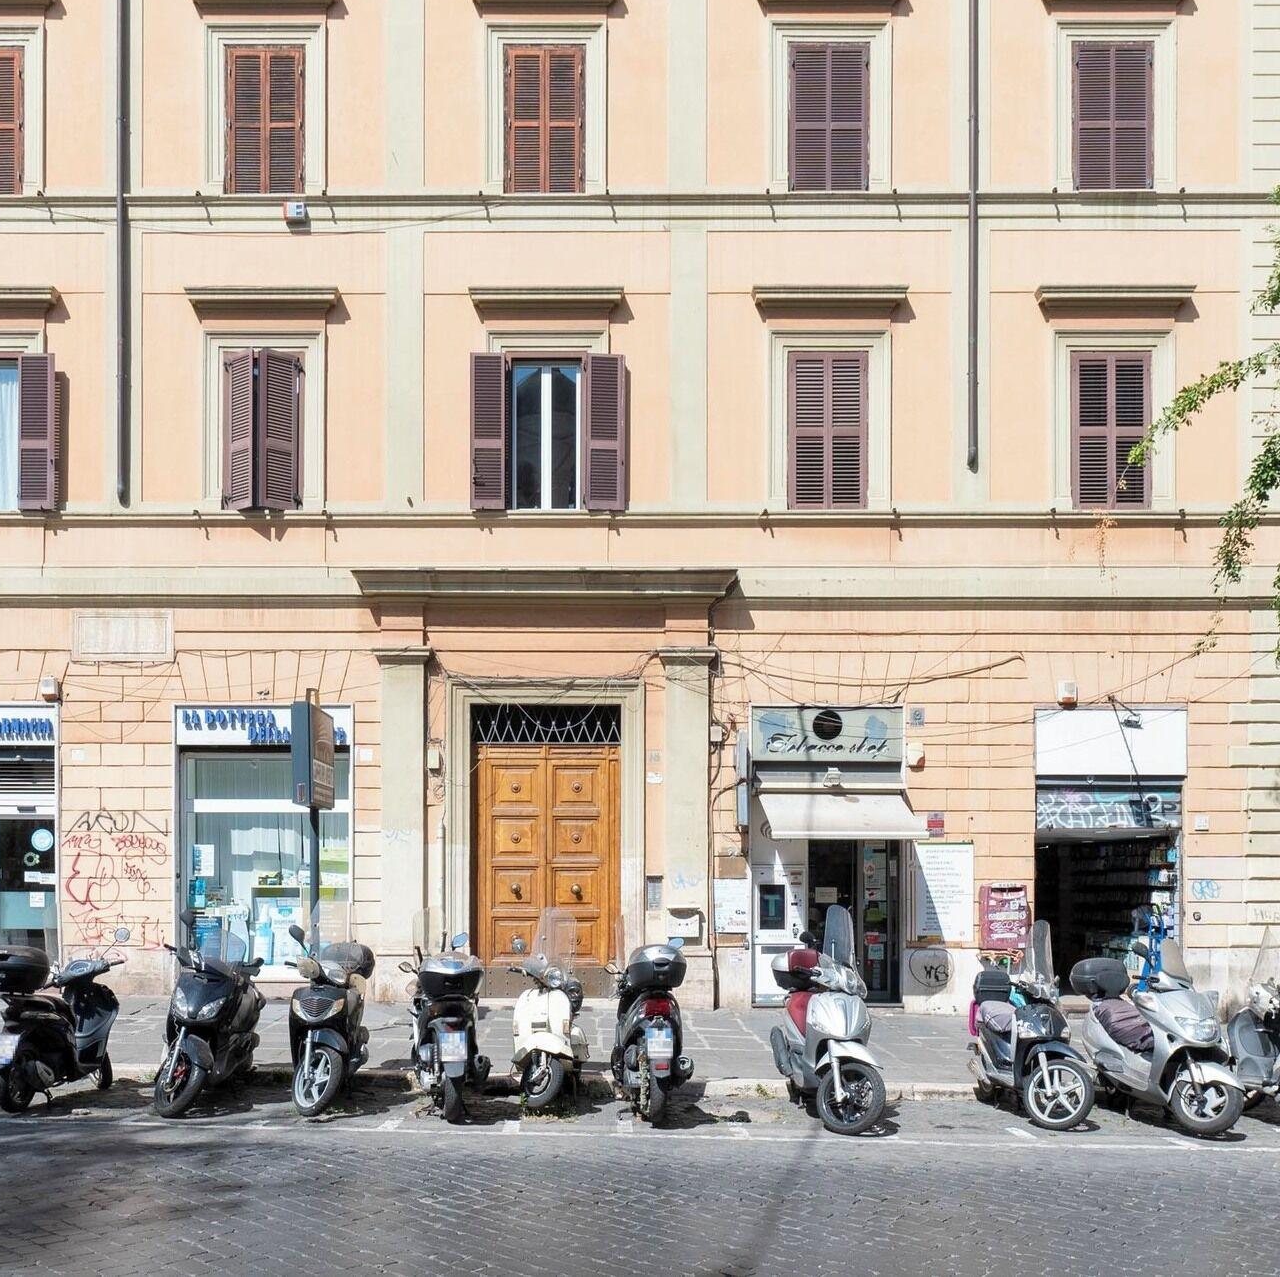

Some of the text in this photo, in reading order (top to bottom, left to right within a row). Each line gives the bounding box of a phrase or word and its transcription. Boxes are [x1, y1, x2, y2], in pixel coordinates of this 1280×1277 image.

[182, 708, 277, 724] LA BOTTEGA
[247, 726, 291, 742] DELLA
[766, 732, 890, 759] Tobacco shop
